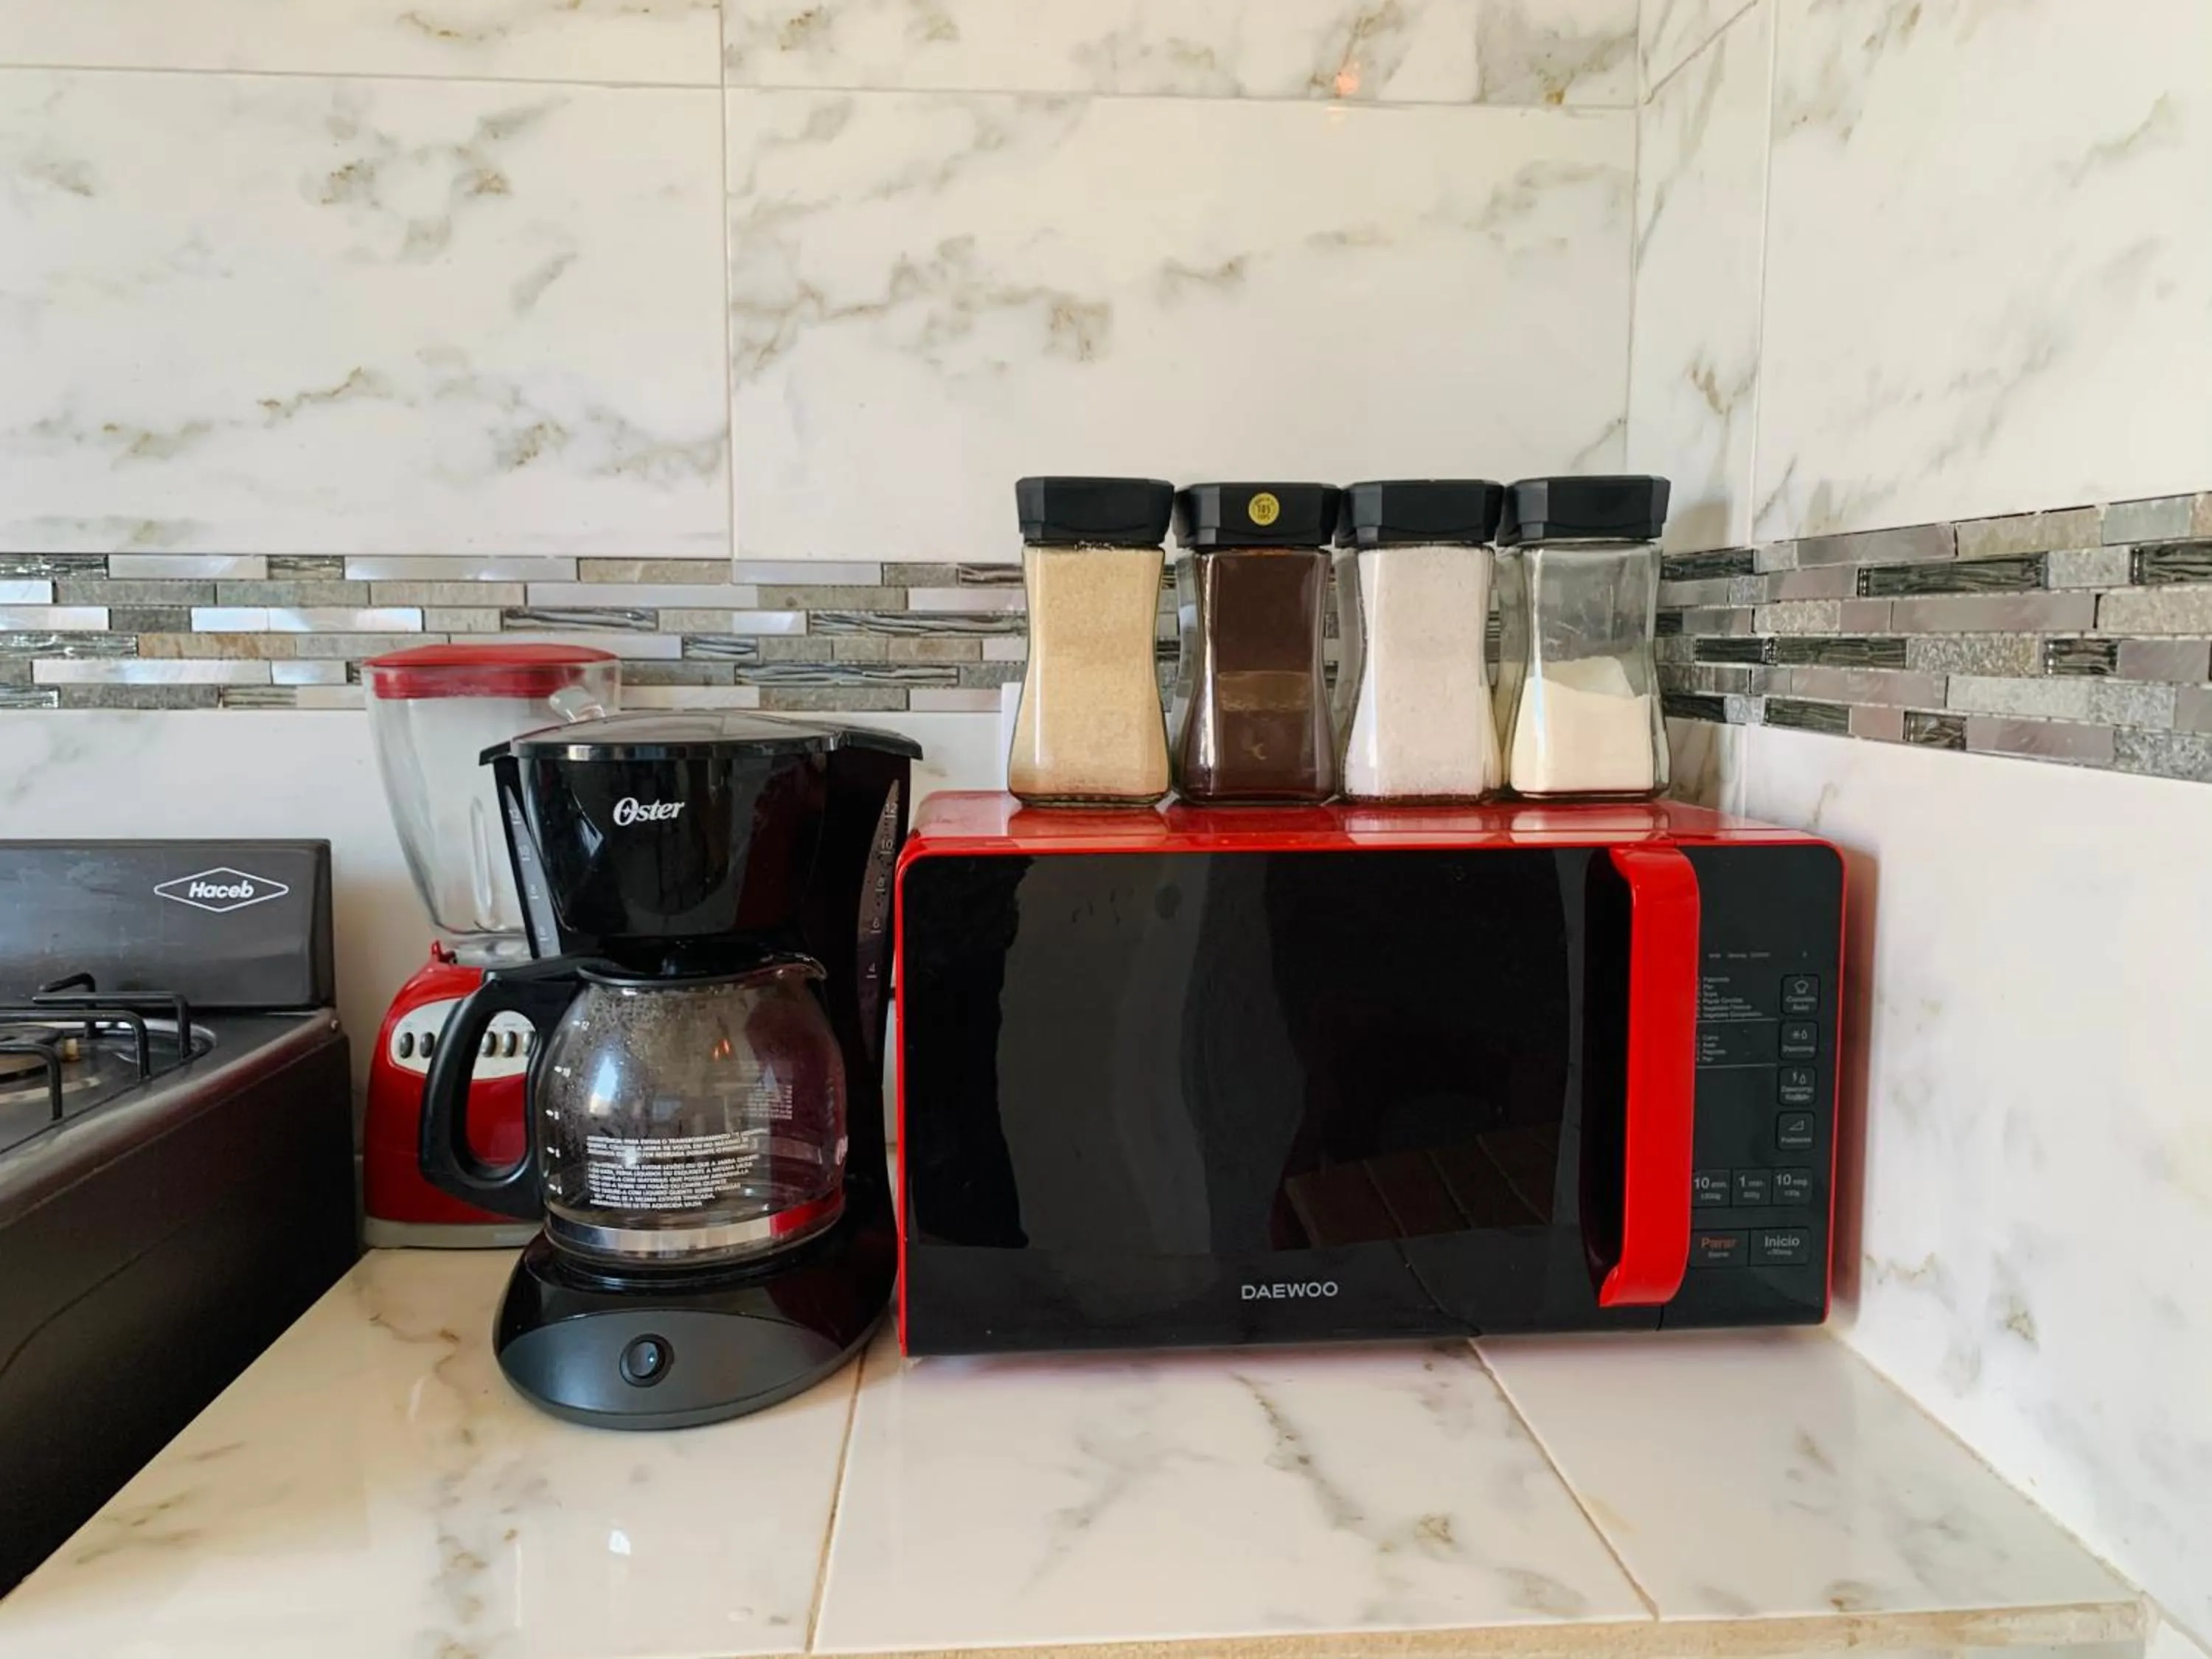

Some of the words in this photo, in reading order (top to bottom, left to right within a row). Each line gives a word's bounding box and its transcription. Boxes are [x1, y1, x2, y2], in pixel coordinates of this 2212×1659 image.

[613, 797, 685, 826] Oster
[189, 880, 254, 899] Haceb
[1694, 1177, 1710, 1189] 10
[1739, 1175, 1745, 1188] 1
[1776, 1174, 1792, 1186] 10
[1764, 1234, 1801, 1248] Inicio
[1240, 1281, 1339, 1300] DAEWOO
